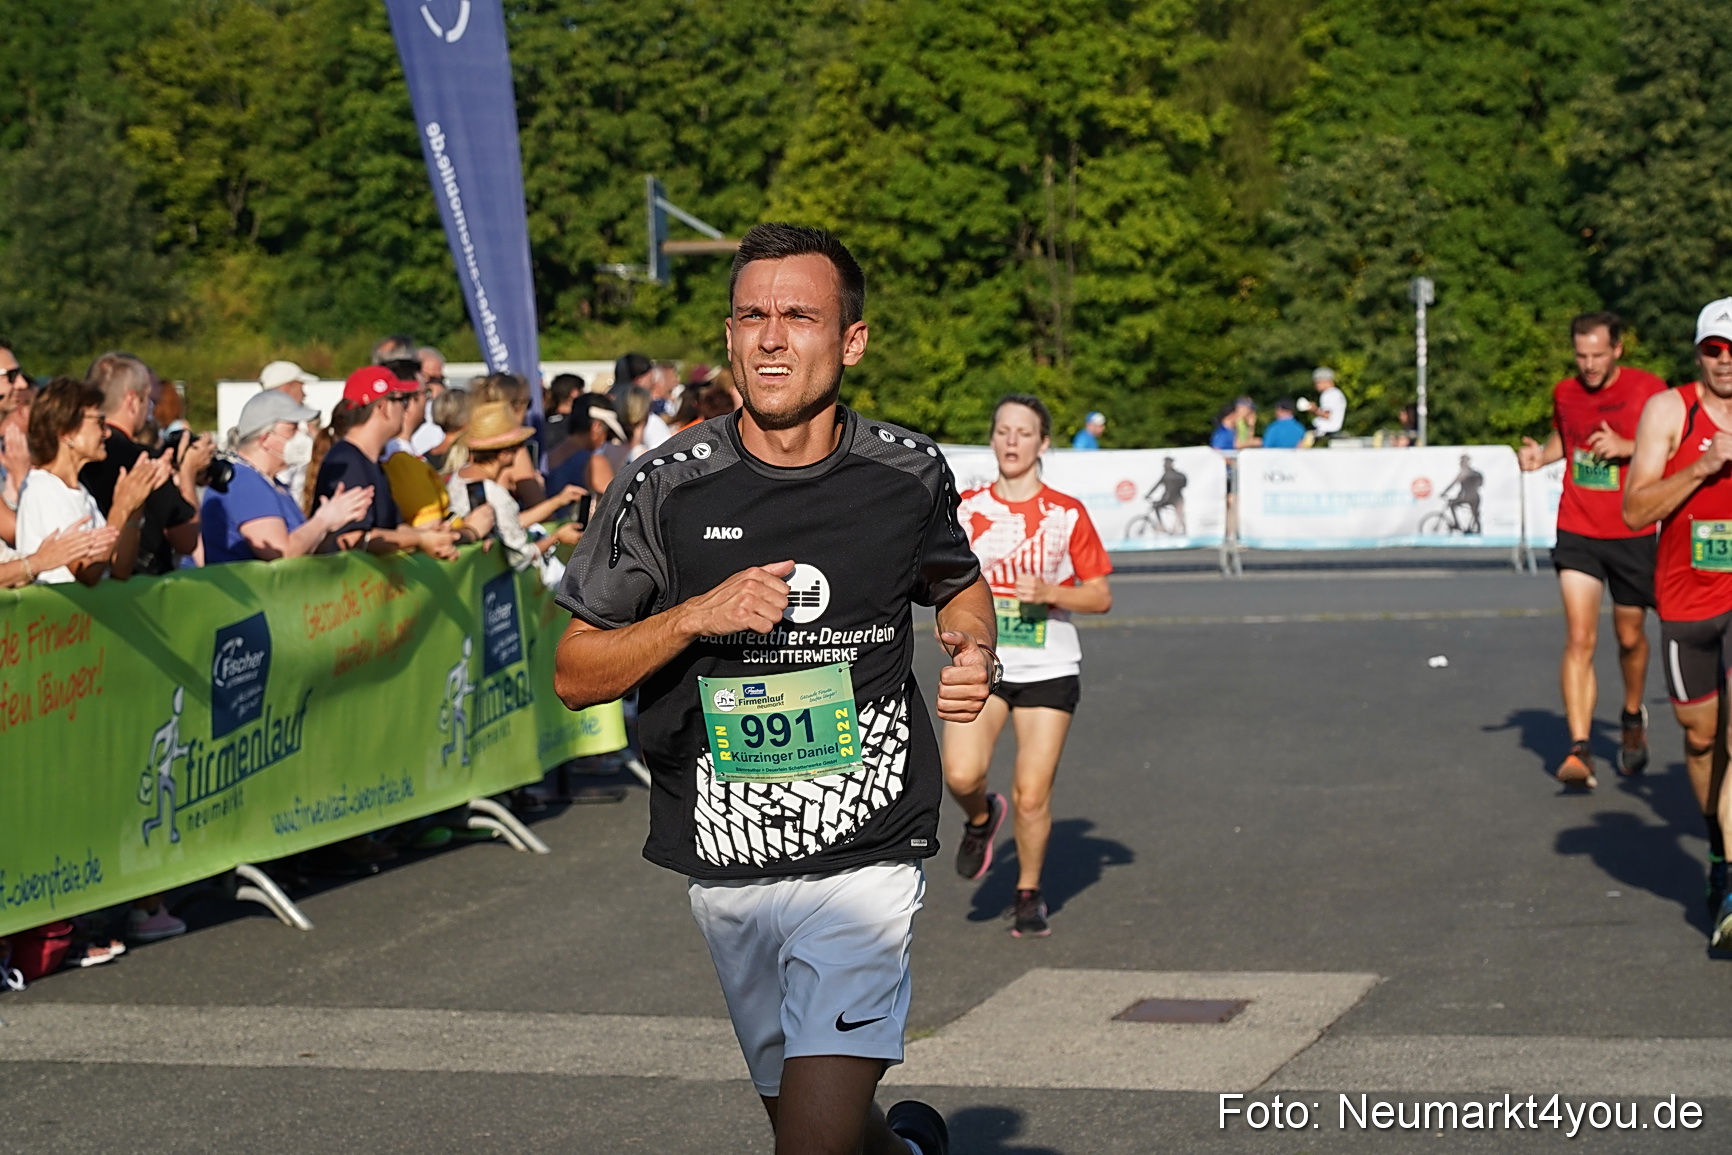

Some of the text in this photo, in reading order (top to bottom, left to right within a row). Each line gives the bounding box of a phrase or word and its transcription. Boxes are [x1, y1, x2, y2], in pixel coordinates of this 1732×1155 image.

[703, 527, 743, 540] JAKO
[743, 647, 858, 663] SCHOTTERWERKE
[739, 693, 784, 706] Firmenlauf
[757, 701, 784, 709] neumarkt
[740, 709, 814, 748] 991
[835, 708, 854, 757] 2022
[186, 686, 312, 804] firmenlauf
[715, 726, 731, 760] RUN
[732, 742, 839, 765] Kürzinger Daniel
